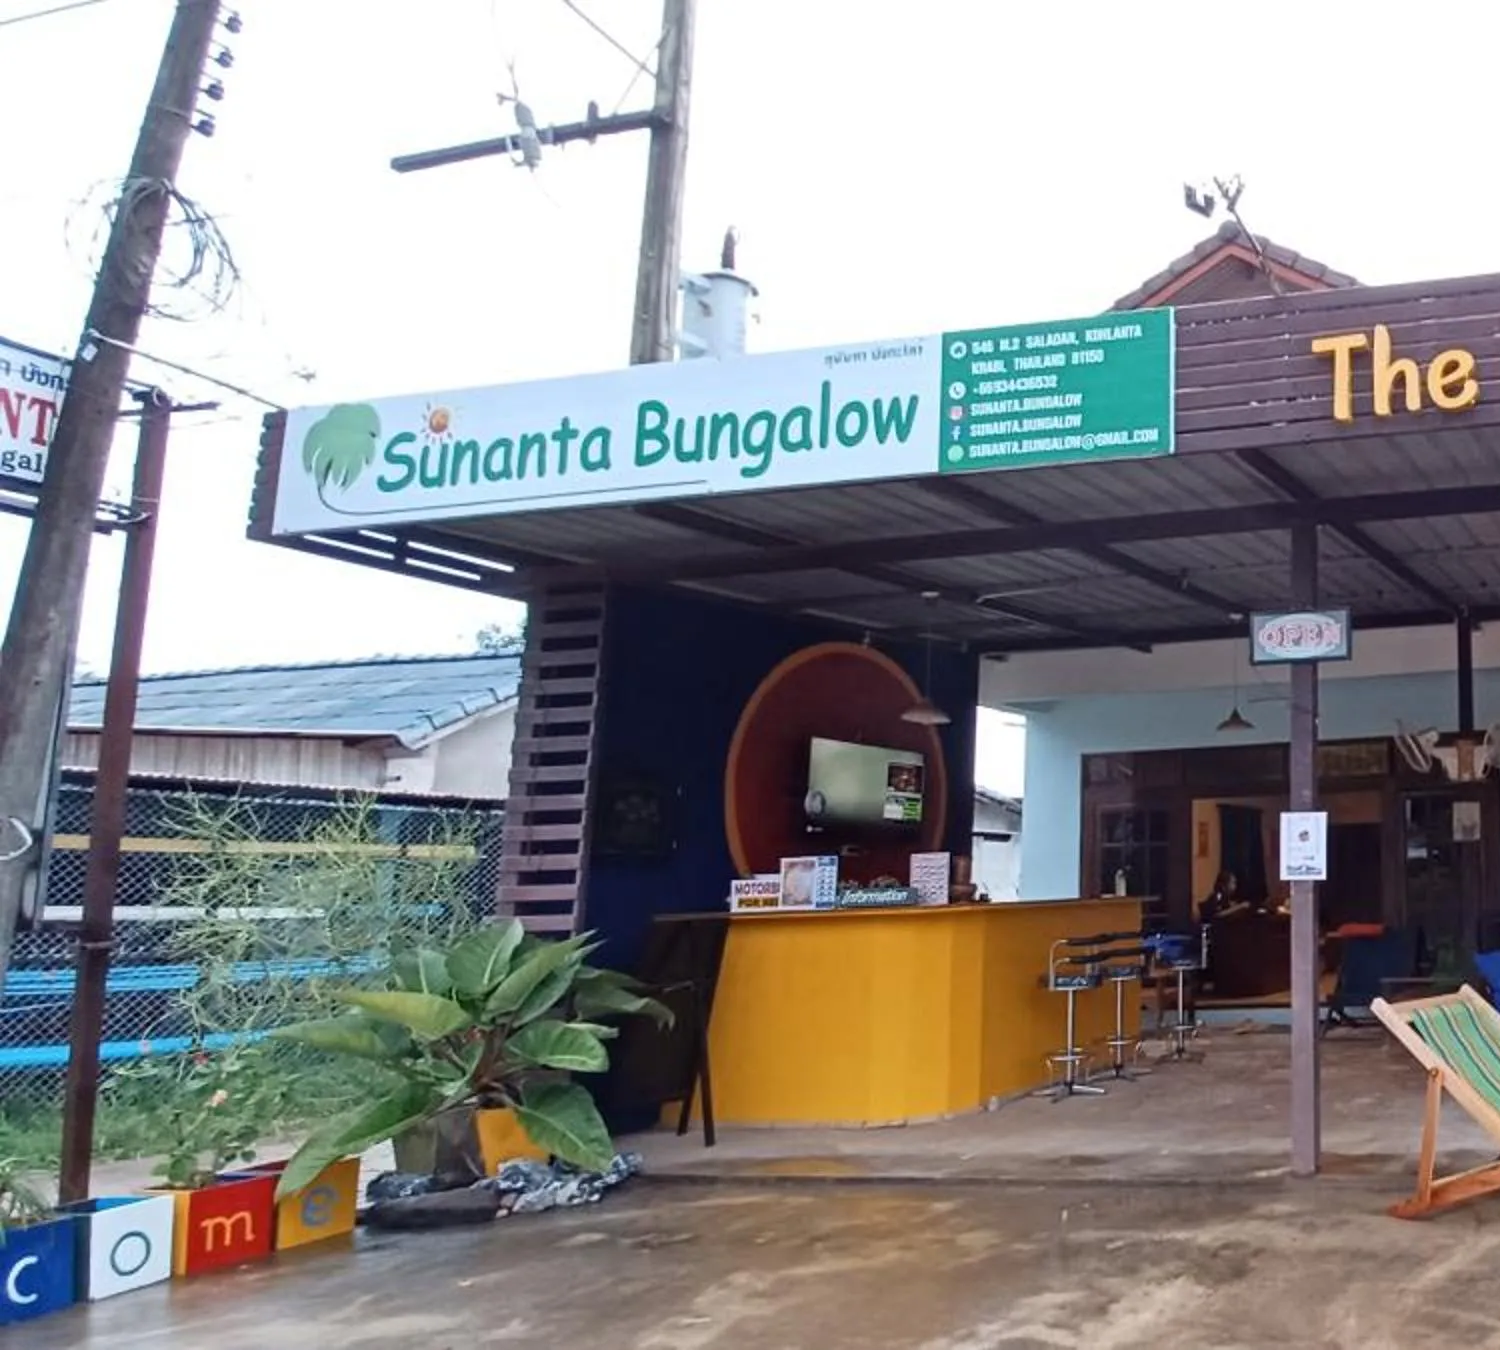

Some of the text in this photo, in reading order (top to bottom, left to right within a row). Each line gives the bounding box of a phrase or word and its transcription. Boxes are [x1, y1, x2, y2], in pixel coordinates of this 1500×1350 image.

[1014, 353, 1066, 371] THAILAND
[1311, 323, 1479, 422] The
[377, 380, 919, 493] Sunanta Bungalow
[1259, 622, 1342, 649] OPEN
[841, 887, 909, 905] Information
